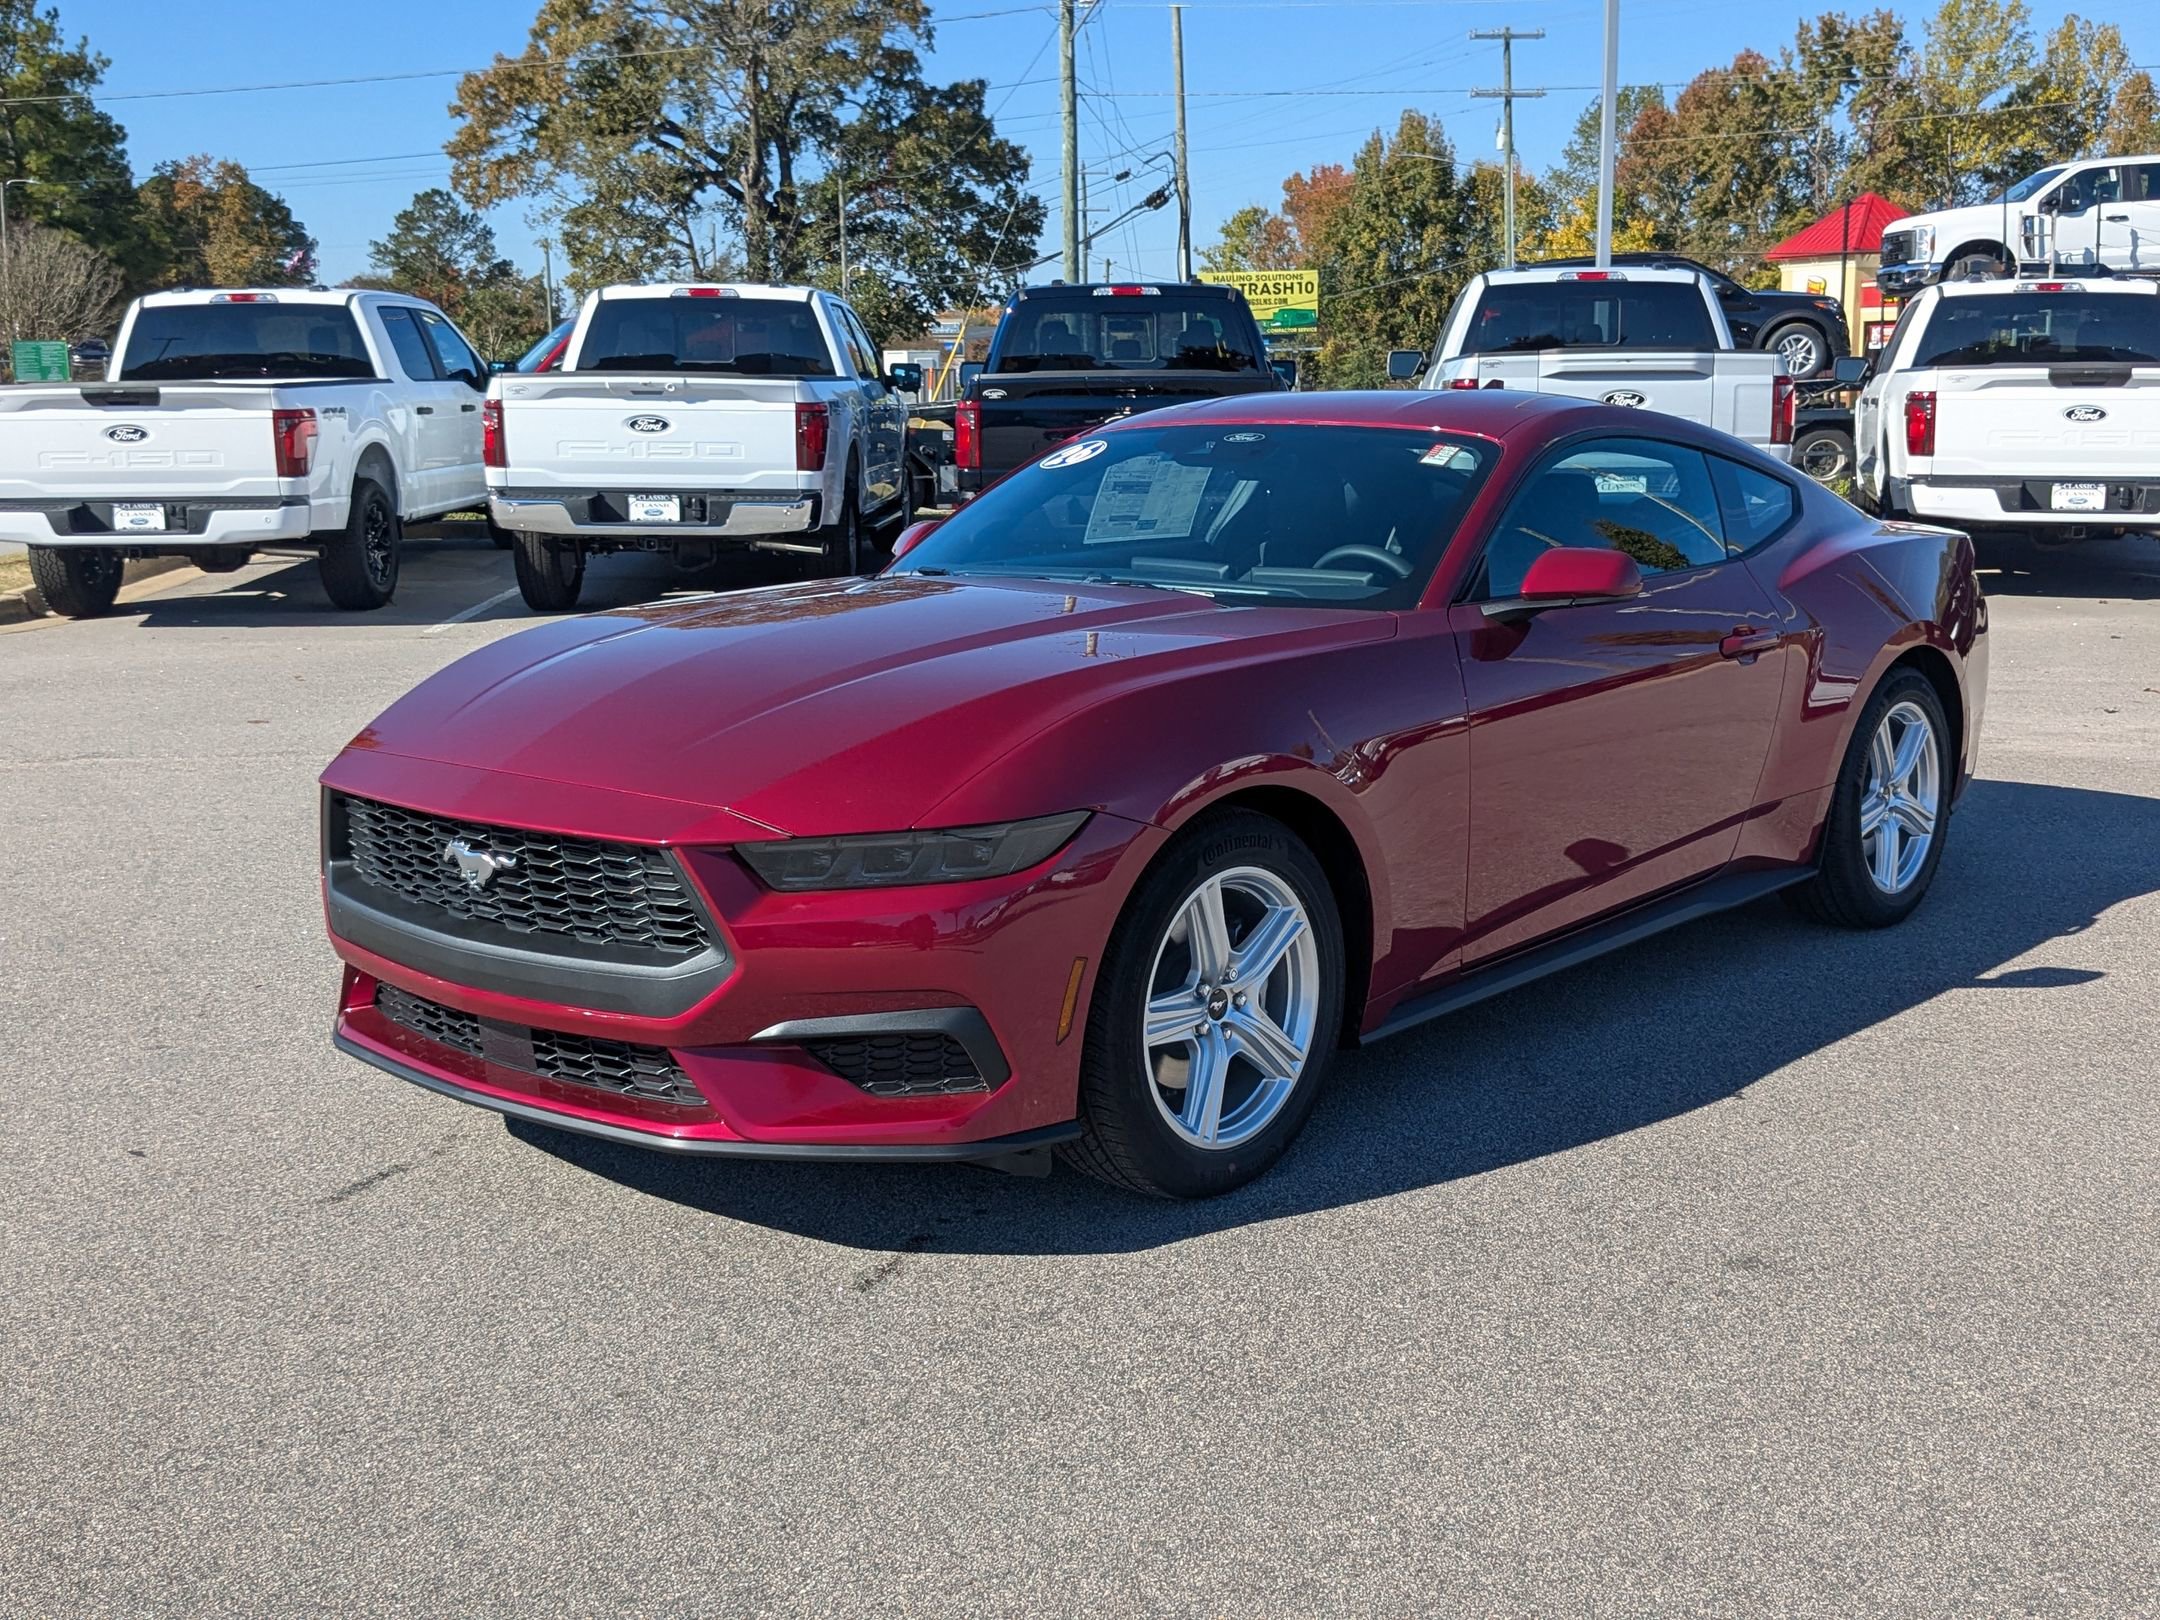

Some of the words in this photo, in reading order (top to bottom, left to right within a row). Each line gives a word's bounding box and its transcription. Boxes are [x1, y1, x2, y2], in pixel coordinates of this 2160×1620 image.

[1213, 275, 1253, 283] HAULING
[1255, 273, 1304, 282] SOLUTIONS
[1240, 281, 1315, 296] TRASH10
[2070, 408, 2102, 421] Ford
[634, 417, 664, 432] Ford
[113, 427, 142, 442] Ford
[556, 440, 745, 459] F-150
[38, 450, 225, 468] F-150
[1202, 834, 1273, 867] Continental
